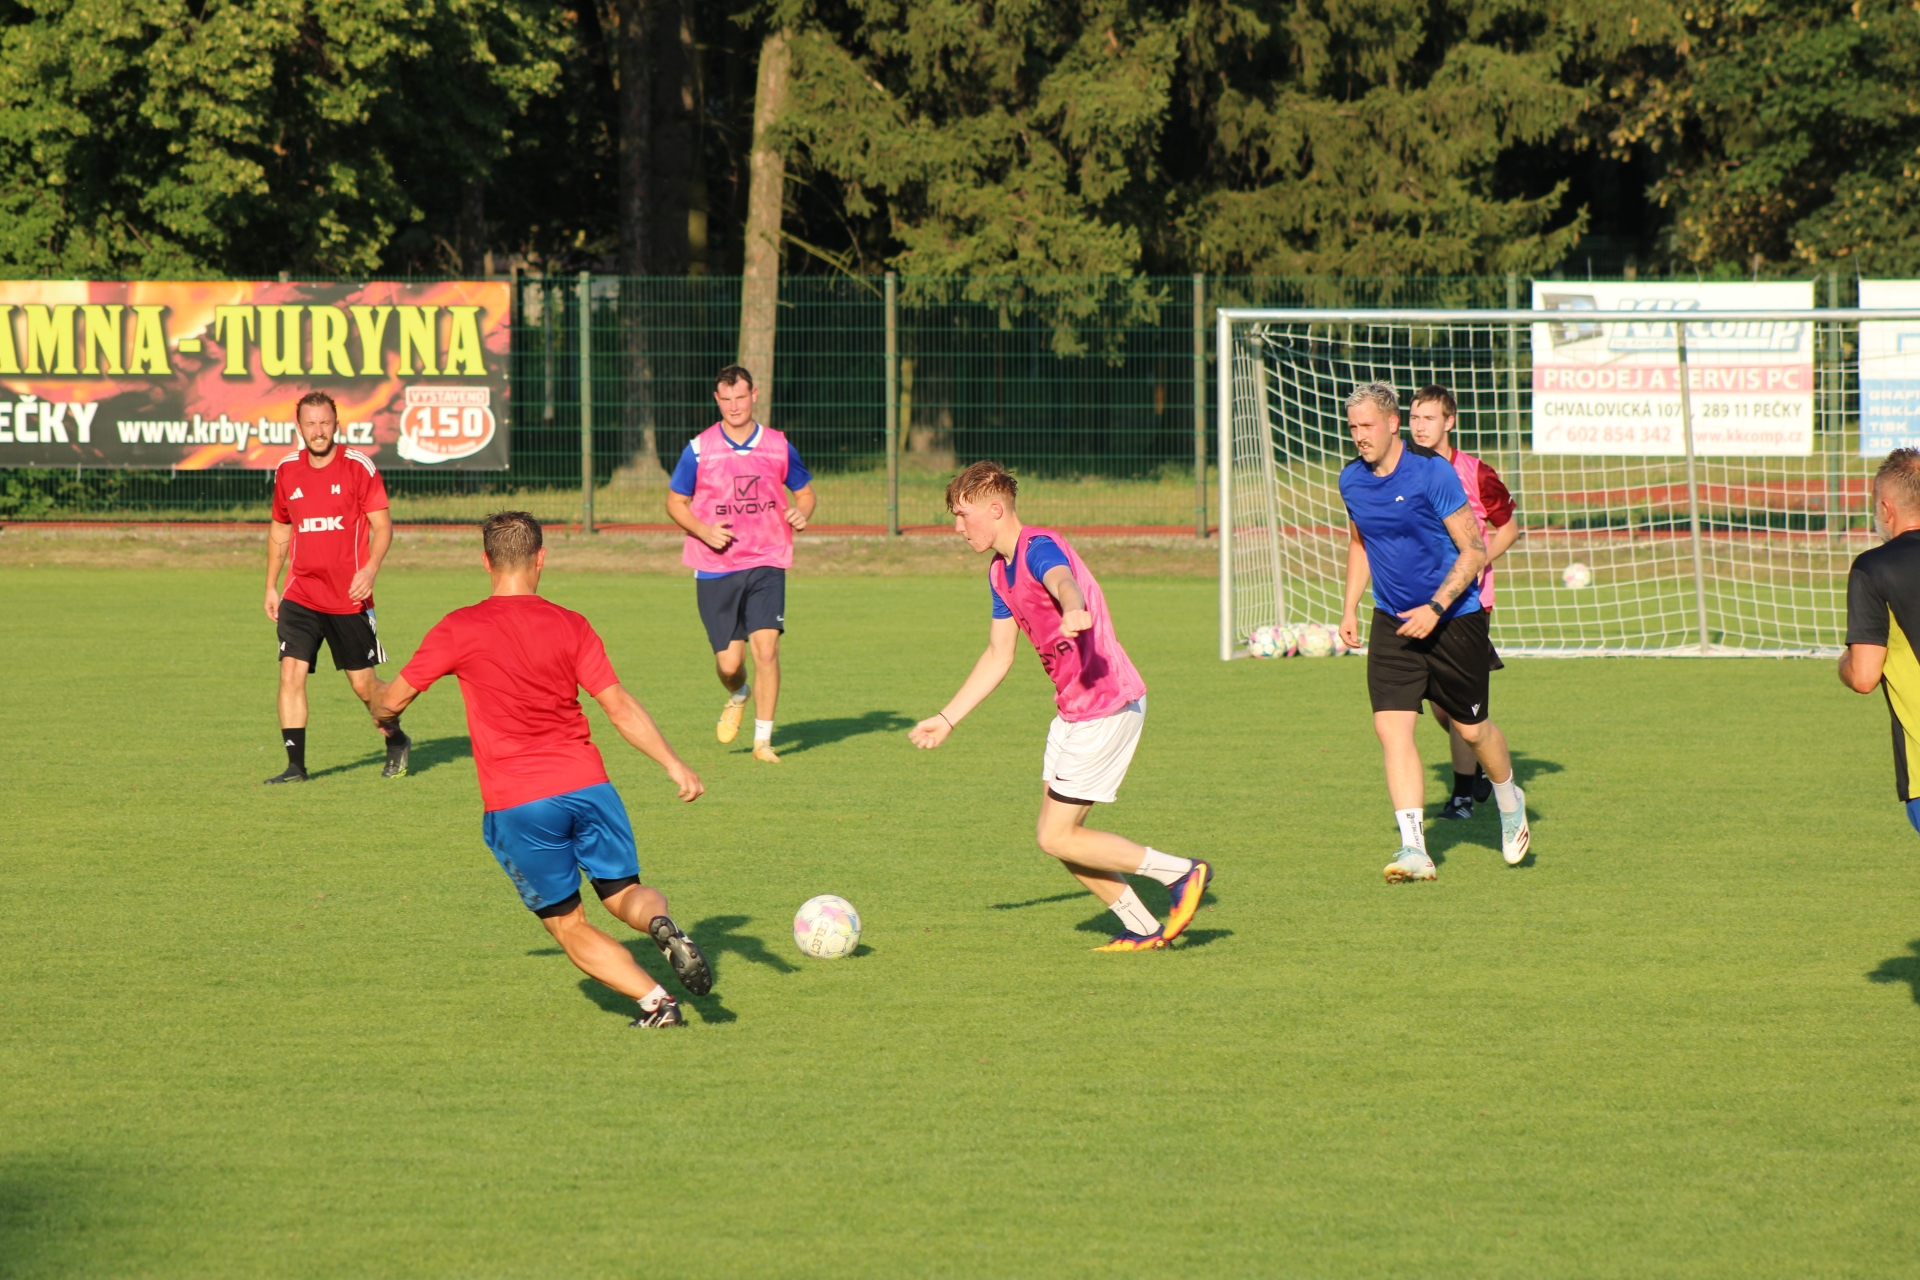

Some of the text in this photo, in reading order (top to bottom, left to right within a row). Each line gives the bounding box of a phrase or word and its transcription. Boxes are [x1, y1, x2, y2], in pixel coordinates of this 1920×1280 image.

[1543, 367, 1799, 390] PRODEJ A SERVIS PC
[1544, 401, 1651, 417] CHVALOVICKÁ
[1703, 404, 1729, 417] 289
[1735, 404, 1747, 417] 11
[1753, 401, 1801, 417] PEČKY
[417, 406, 483, 438] 150
[1566, 426, 1803, 444] 602 854 342 ww.kkcomp.cz
[331, 484, 341, 495] 14
[715, 500, 776, 515] GIVOVA
[298, 516, 345, 533] JDK
